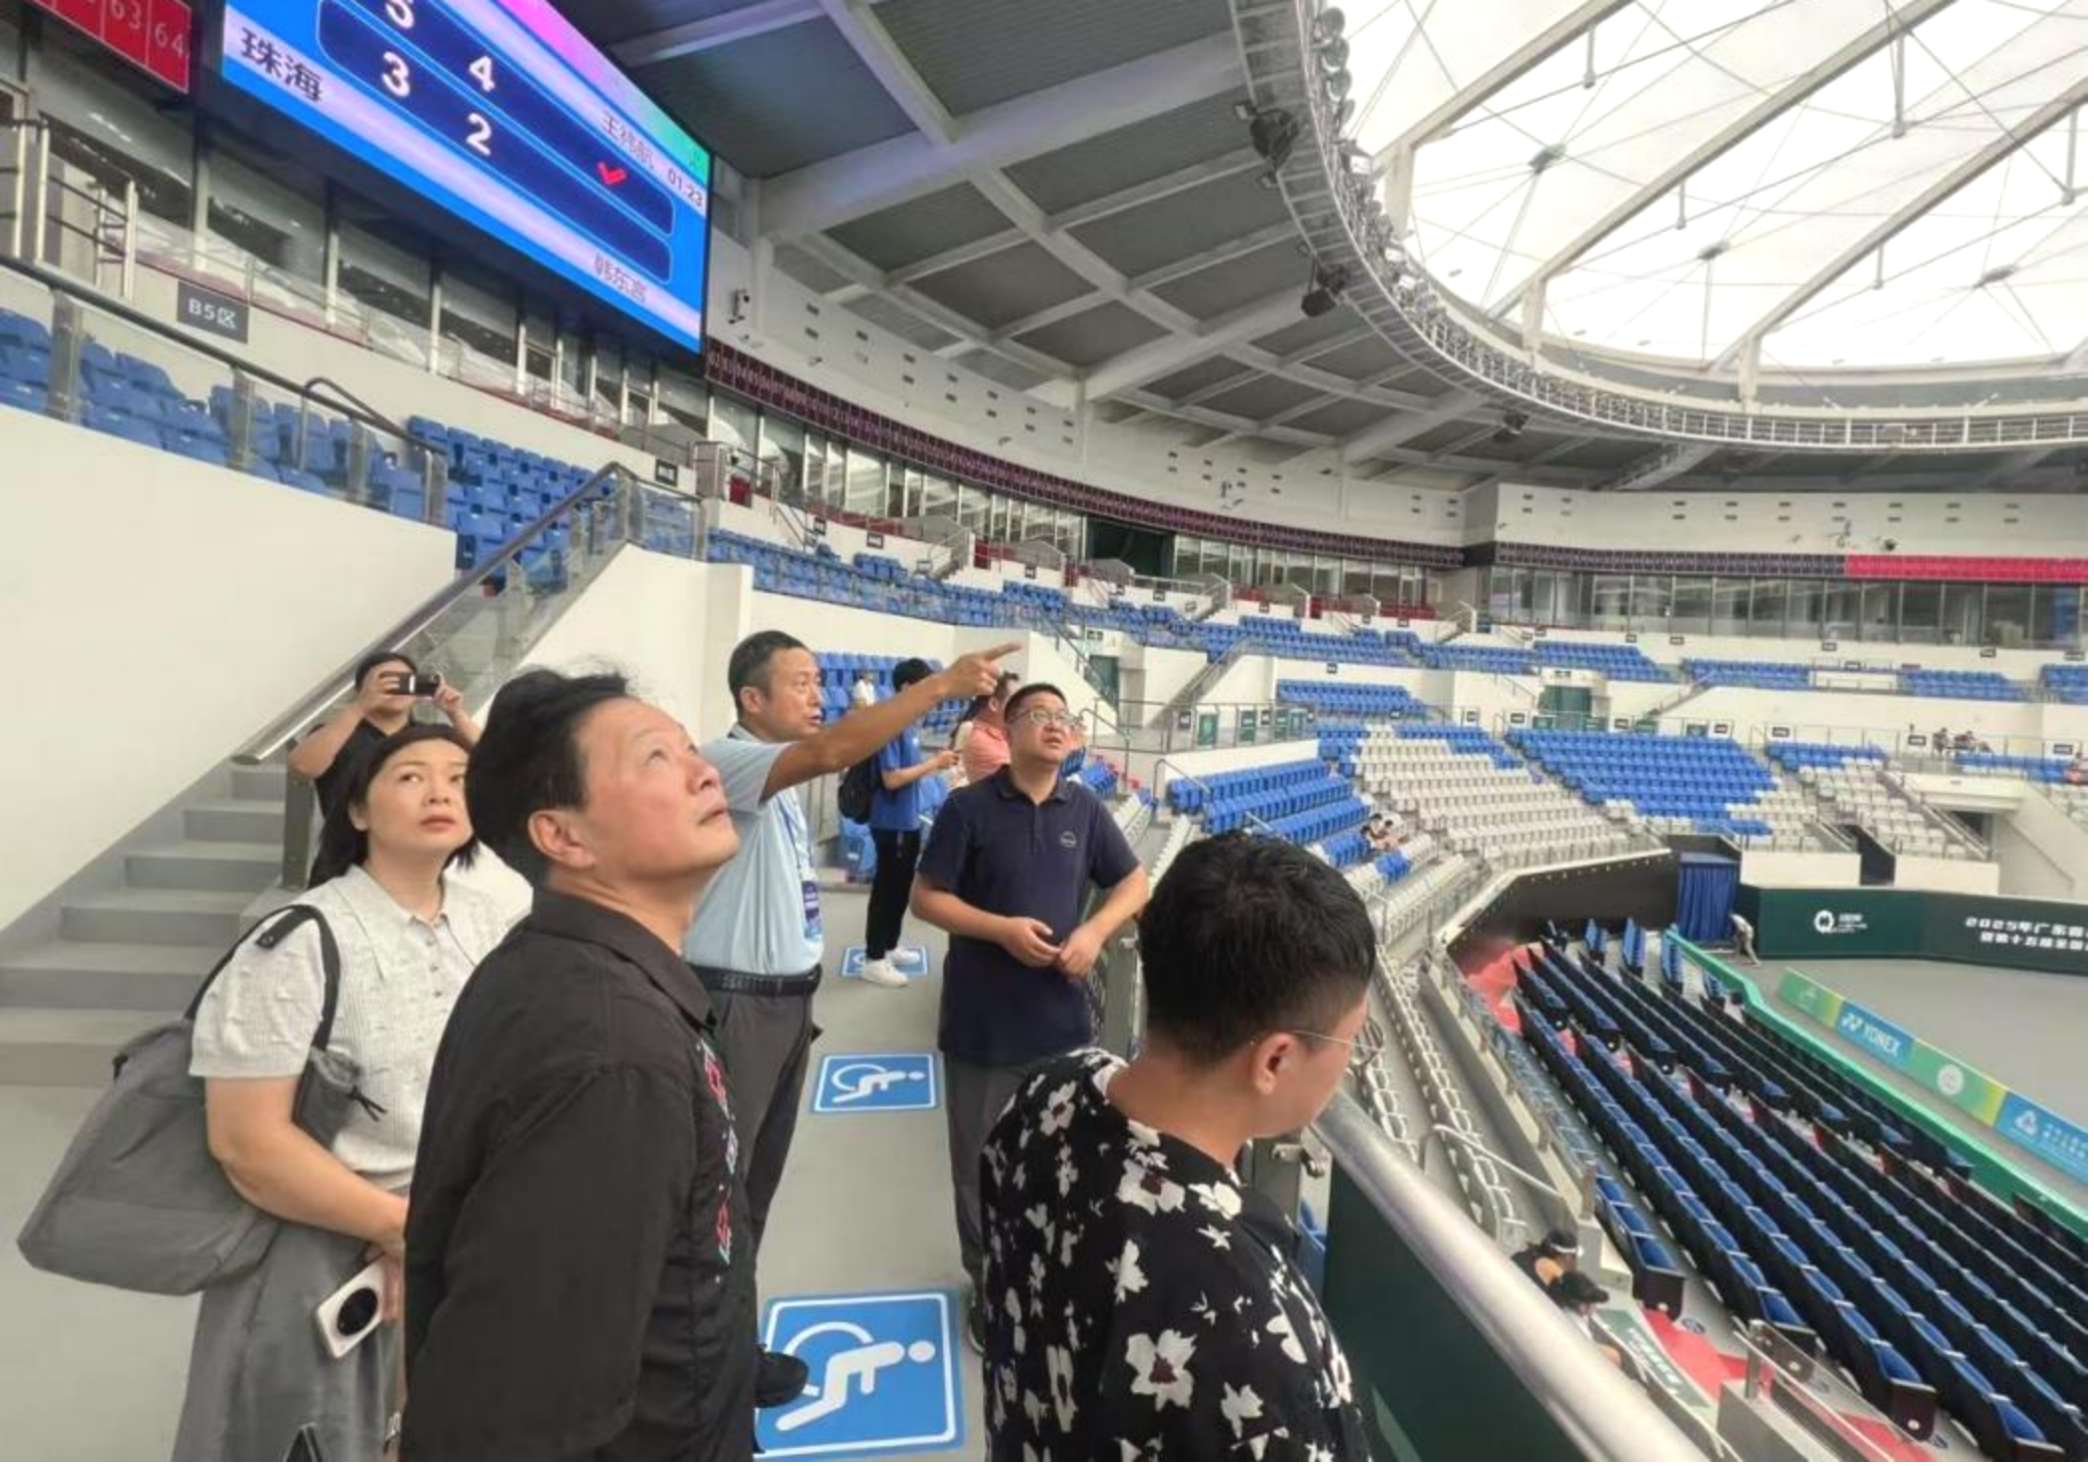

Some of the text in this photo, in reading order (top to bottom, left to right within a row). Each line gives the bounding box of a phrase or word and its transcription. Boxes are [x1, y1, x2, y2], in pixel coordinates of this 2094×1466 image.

[154, 22, 186, 59] 64
[240, 26, 324, 102] 珠海
[468, 55, 495, 92] 4
[381, 51, 493, 156] 3 2
[188, 297, 238, 331] B5区
[1862, 1023, 1903, 1057] YONEX
